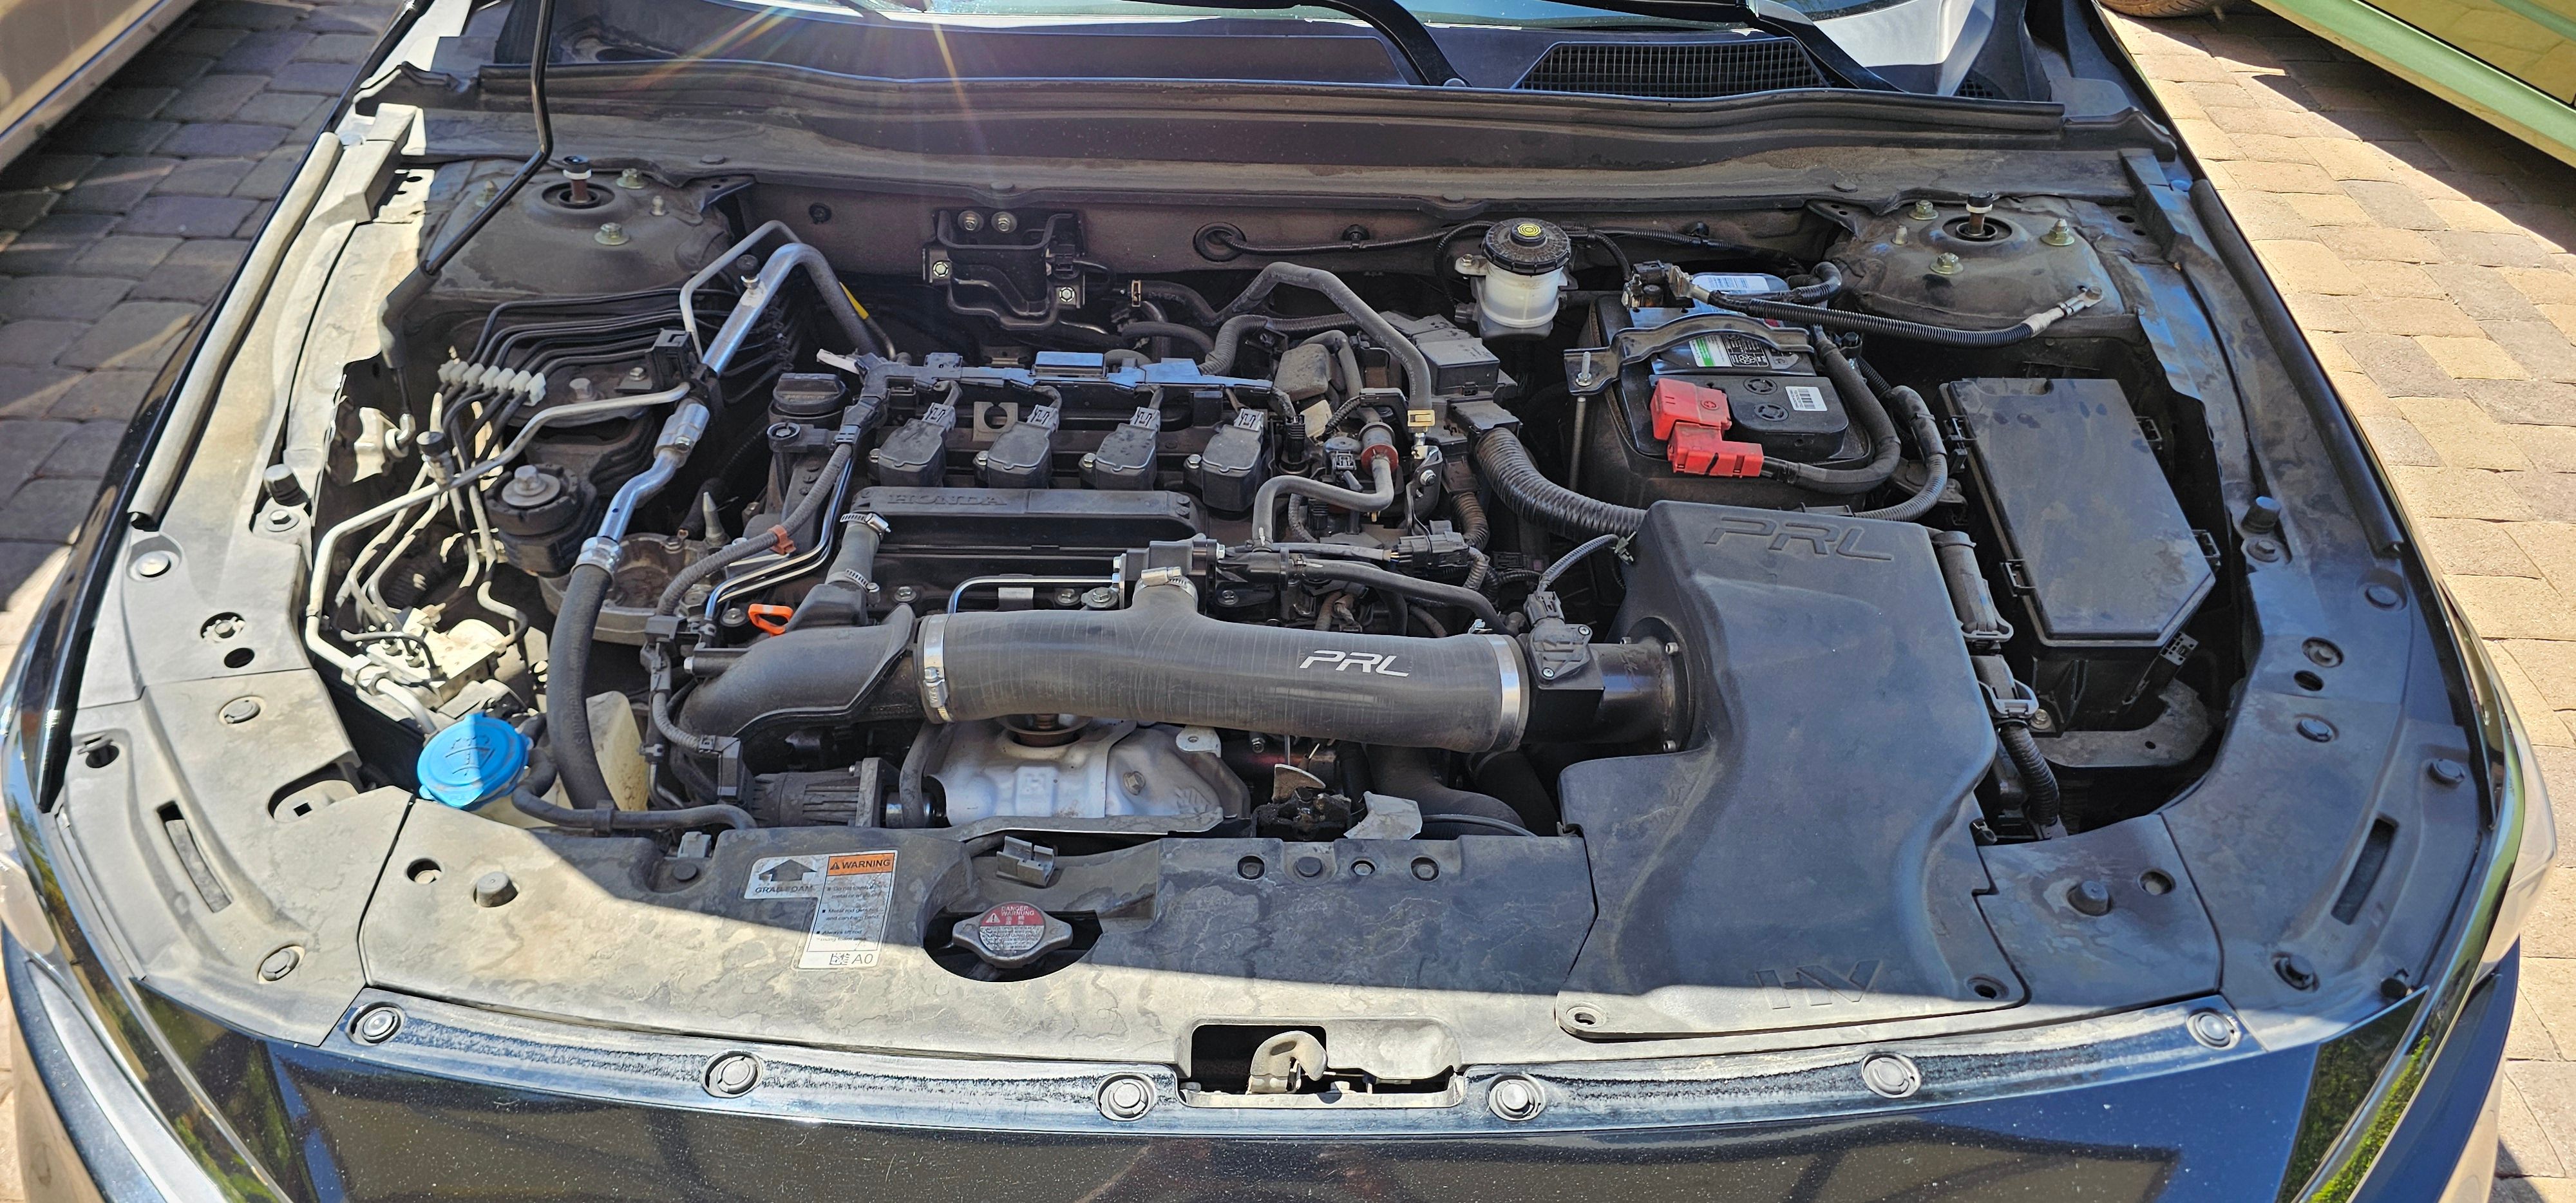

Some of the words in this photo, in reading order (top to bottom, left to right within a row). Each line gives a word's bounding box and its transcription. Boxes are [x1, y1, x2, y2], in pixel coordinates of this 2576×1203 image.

[887, 494, 1007, 506] HONDA
[1703, 516, 1894, 562] PRL
[1299, 650, 1410, 677] PRL
[842, 859, 891, 869] WARNING
